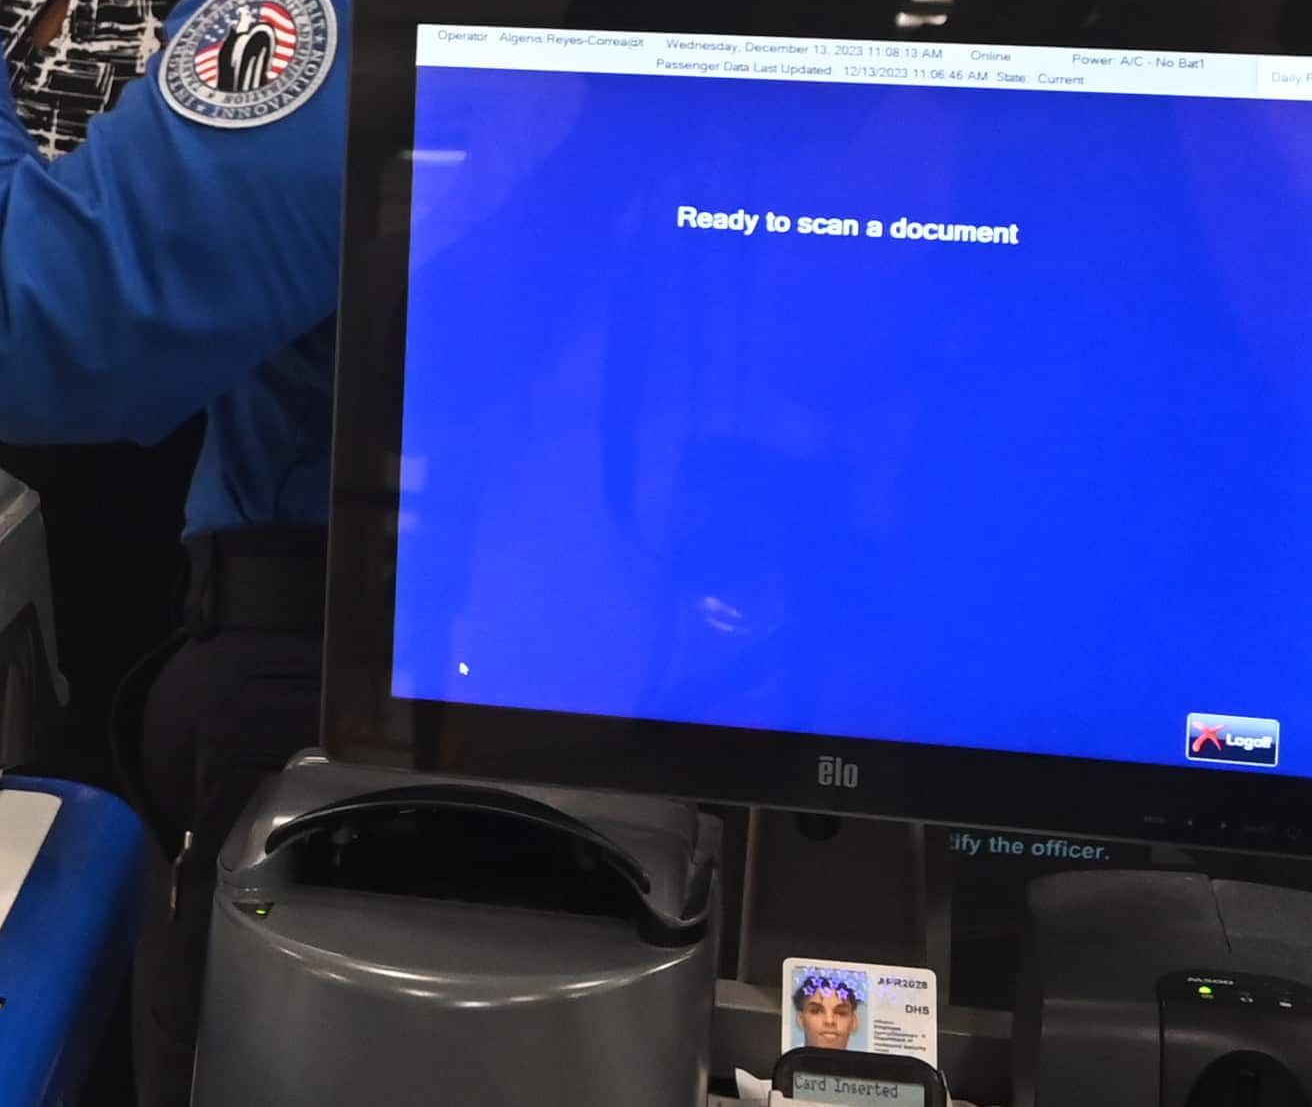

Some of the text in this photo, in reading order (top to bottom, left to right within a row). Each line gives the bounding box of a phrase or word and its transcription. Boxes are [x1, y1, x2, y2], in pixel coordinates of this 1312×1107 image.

[745, 41, 809, 55] December
[834, 44, 864, 56] 2023
[922, 48, 943, 59] AM
[970, 50, 1012, 62] Online
[1156, 57, 1175, 69] No
[209, 48, 324, 120] INNOVATION
[656, 58, 720, 73] Passenger
[723, 60, 750, 72] Data
[753, 61, 777, 74] Last
[843, 66, 908, 79] 12/13/2023
[967, 70, 989, 82] AM
[1037, 73, 1085, 86] Current
[677, 205, 1020, 245] Ready to scan a document
[1225, 732, 1273, 751] Logoff
[989, 835, 1025, 855] the
[1031, 839, 1111, 861] officer.
[794, 1075, 899, 1098] Card Inserted
